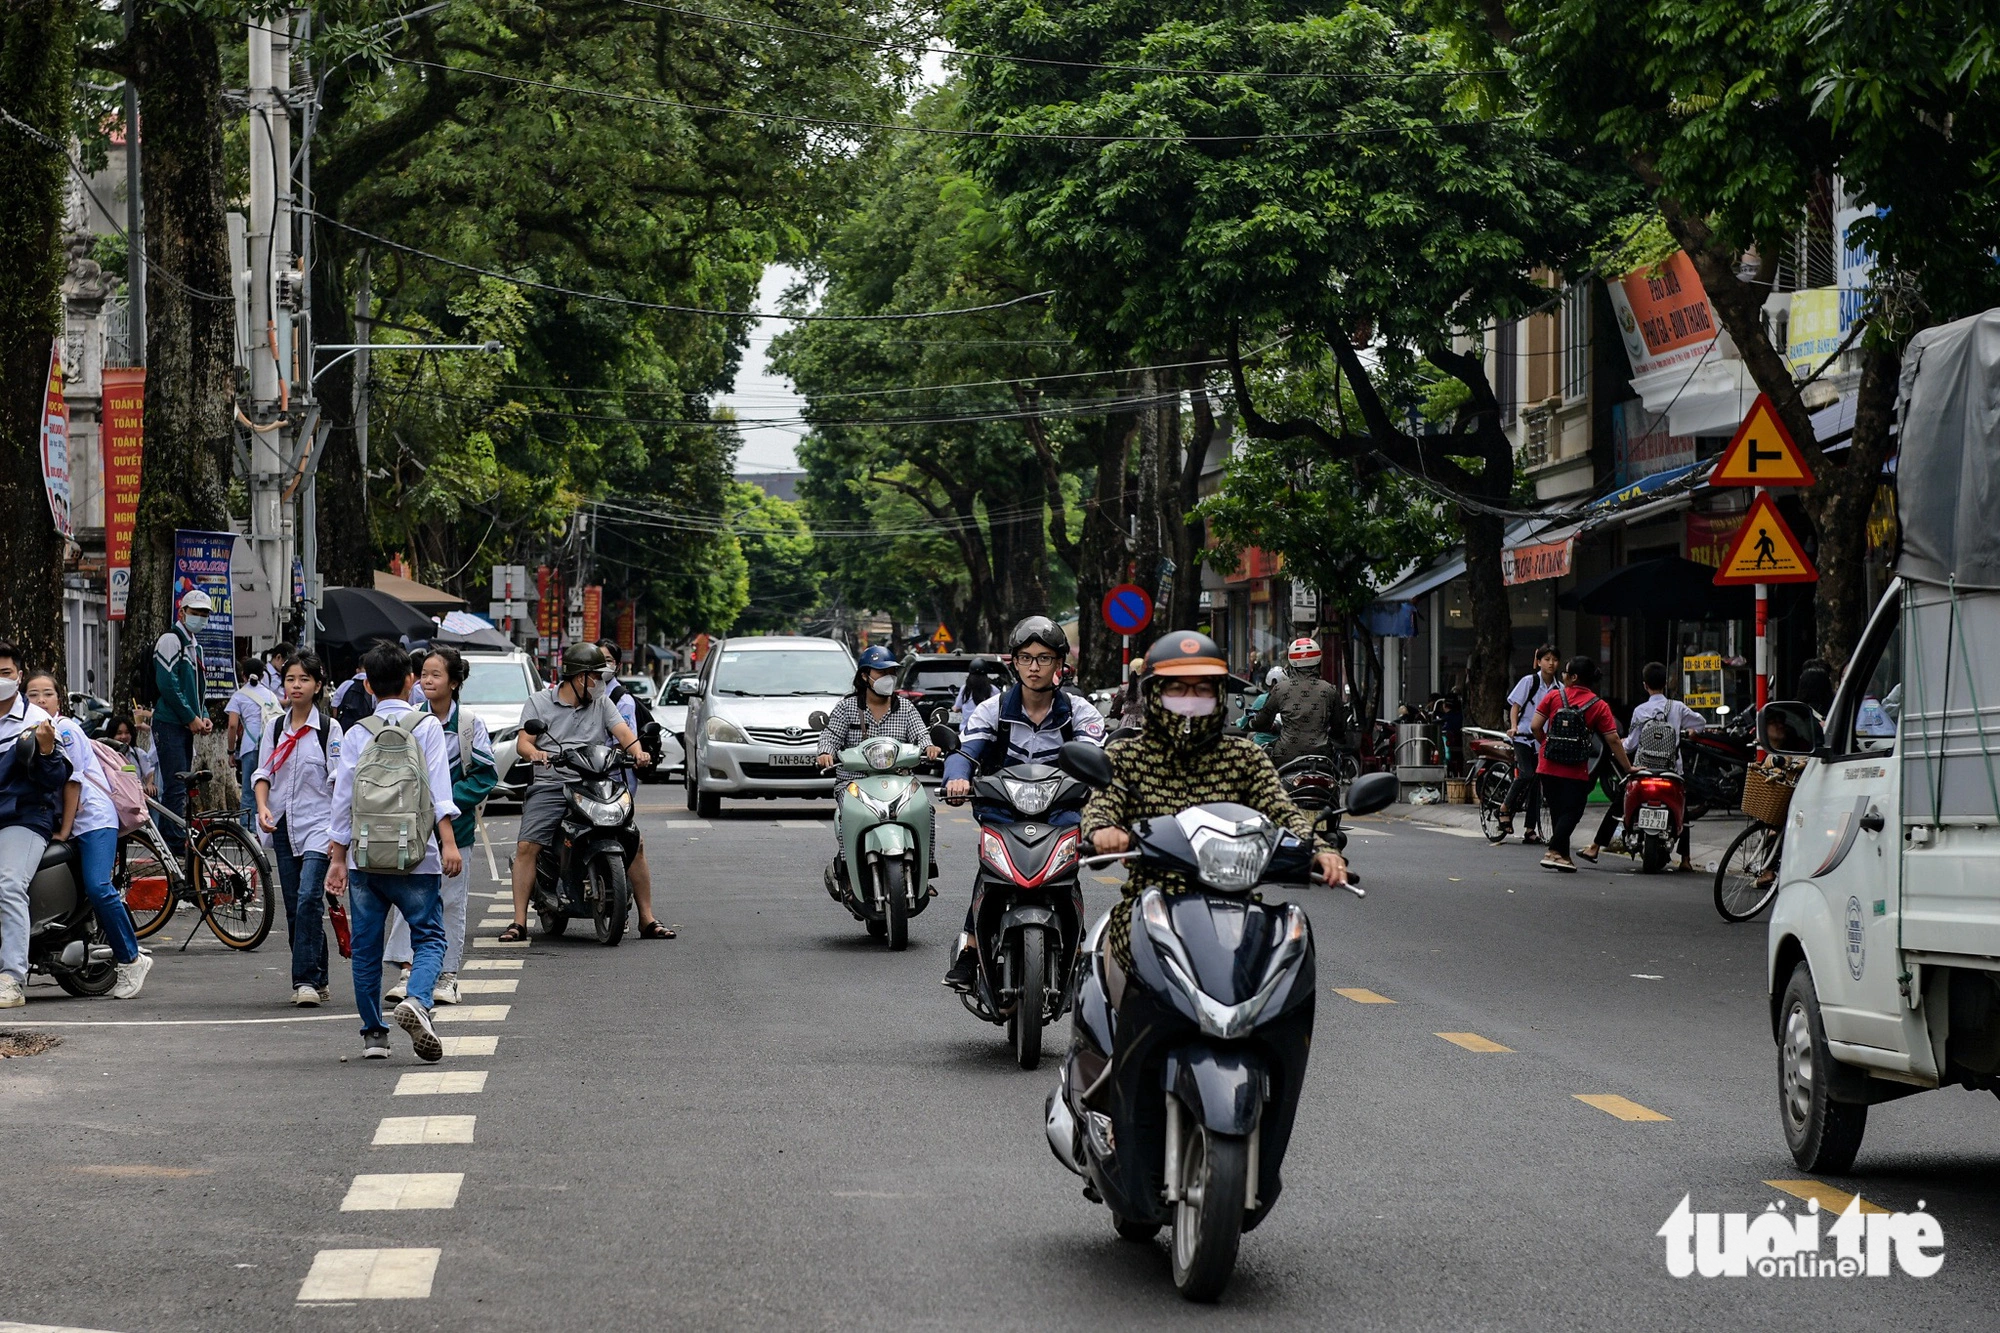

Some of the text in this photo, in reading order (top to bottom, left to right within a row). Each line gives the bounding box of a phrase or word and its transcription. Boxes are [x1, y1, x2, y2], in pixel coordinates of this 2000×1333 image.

[1683, 301, 1710, 335] THANG
[110, 397, 134, 410] TOÀN
[113, 416, 137, 429] TOÀN
[112, 434, 137, 447] TOÀN
[115, 474, 139, 487] THỰC
